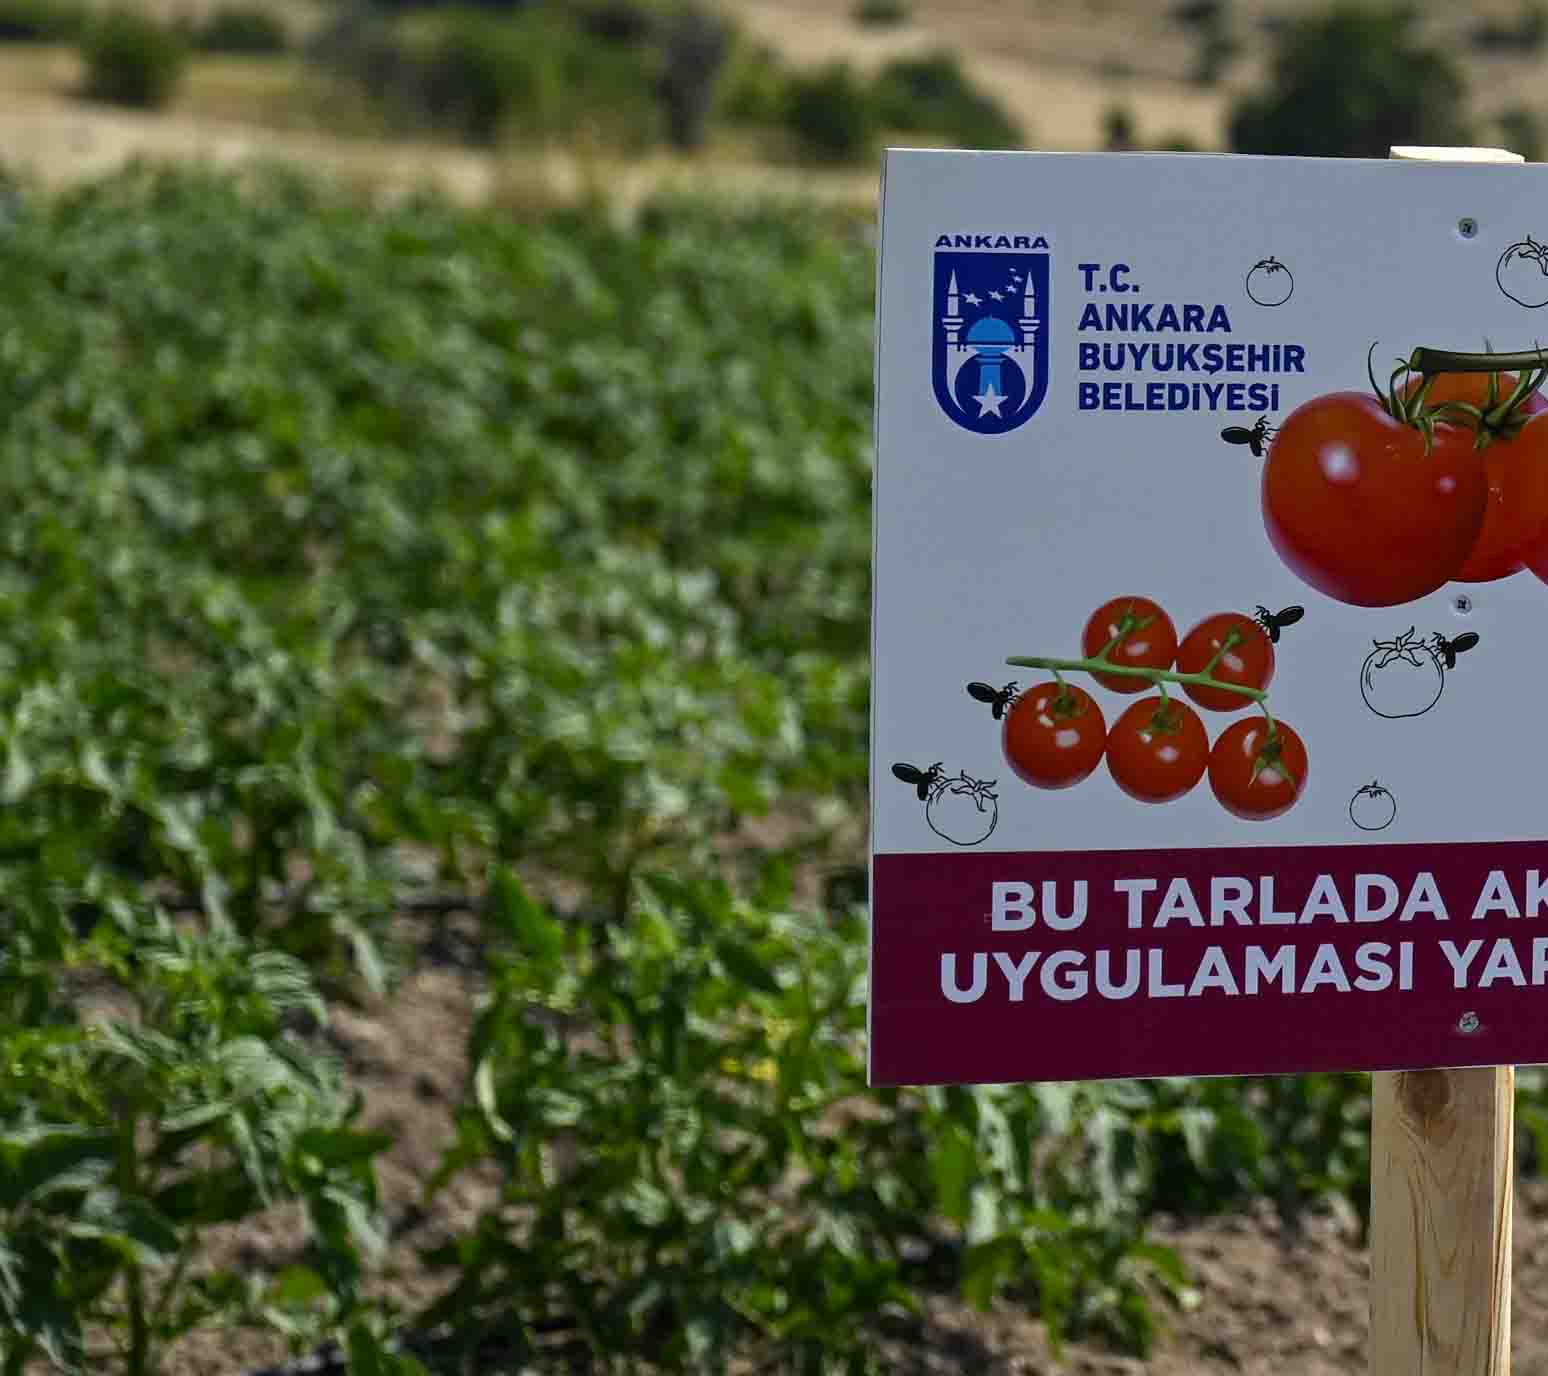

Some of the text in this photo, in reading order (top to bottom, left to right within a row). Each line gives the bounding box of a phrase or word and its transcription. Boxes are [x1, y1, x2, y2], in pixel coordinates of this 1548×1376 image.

[934, 235, 1050, 249] ANKARA
[1077, 263, 1141, 293] T.C.
[1077, 303, 1233, 333] ANKARA
[1078, 382, 1280, 412] BELEDİYESİ
[990, 879, 1090, 932] BU
[1113, 871, 1450, 929] TARLADA
[940, 940, 1415, 1004] UYGULAMASI
